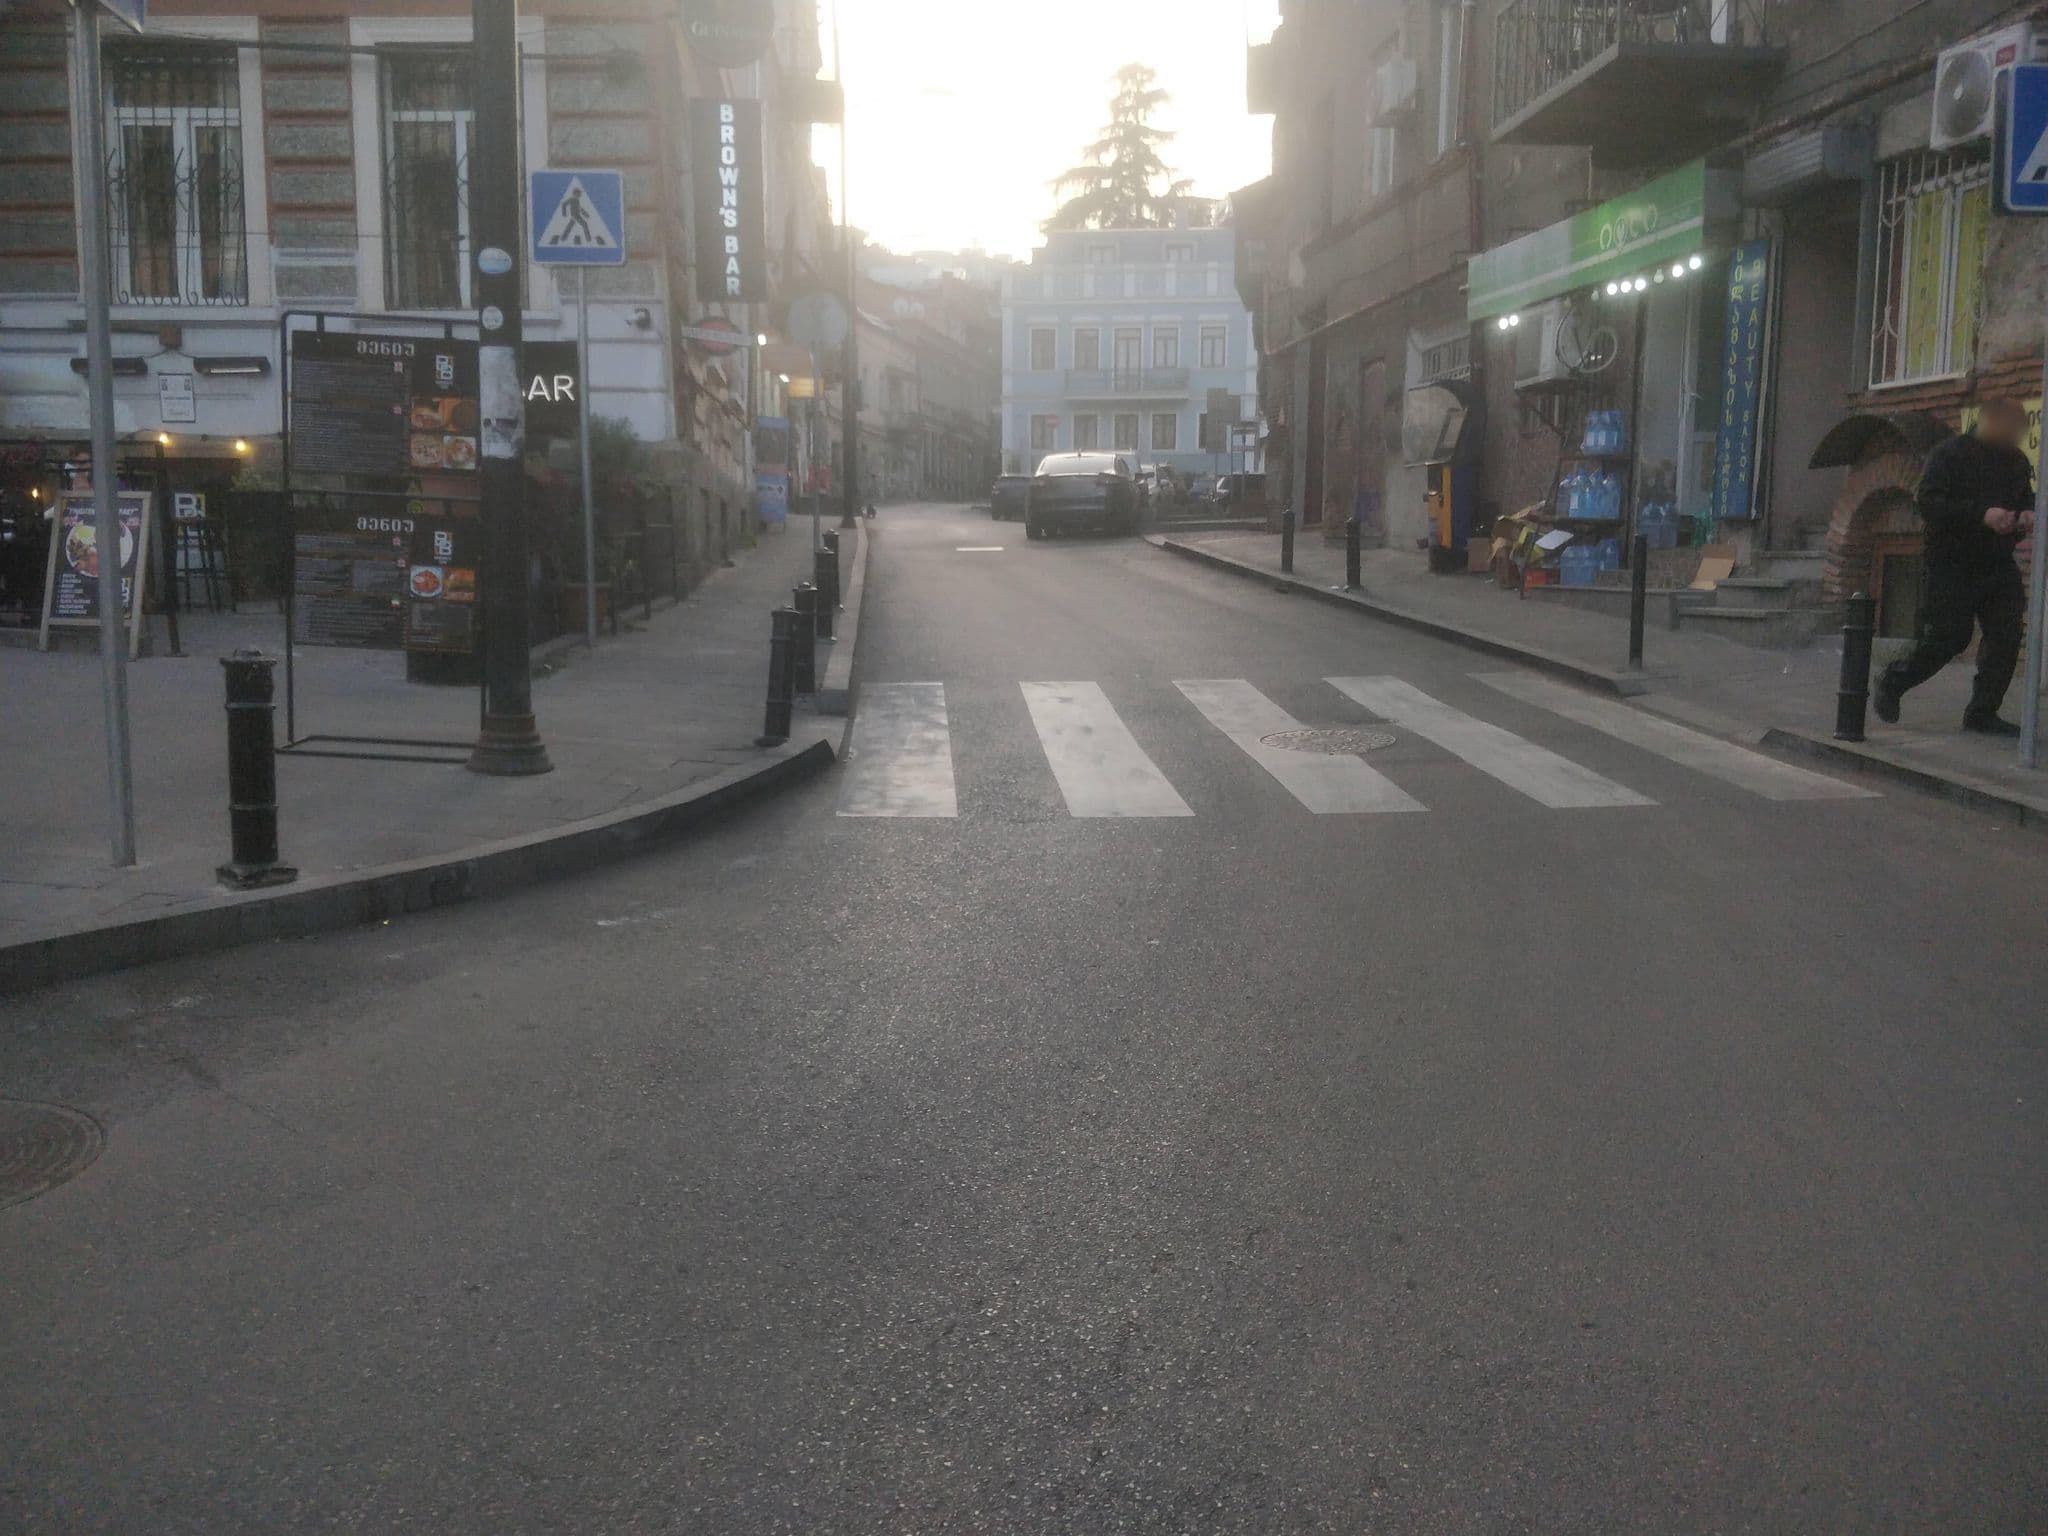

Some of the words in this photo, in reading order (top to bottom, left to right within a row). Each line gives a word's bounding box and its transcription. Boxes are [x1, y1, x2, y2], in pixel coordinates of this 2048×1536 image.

[718, 103, 739, 228] BROWN'S
[725, 235, 740, 296] BAR
[357, 339, 415, 356] მენიუ
[1745, 258, 1761, 399] BEAUTY
[522, 374, 575, 402] AR
[1739, 409, 1750, 483] SALON
[356, 516, 415, 533] მენიუ
